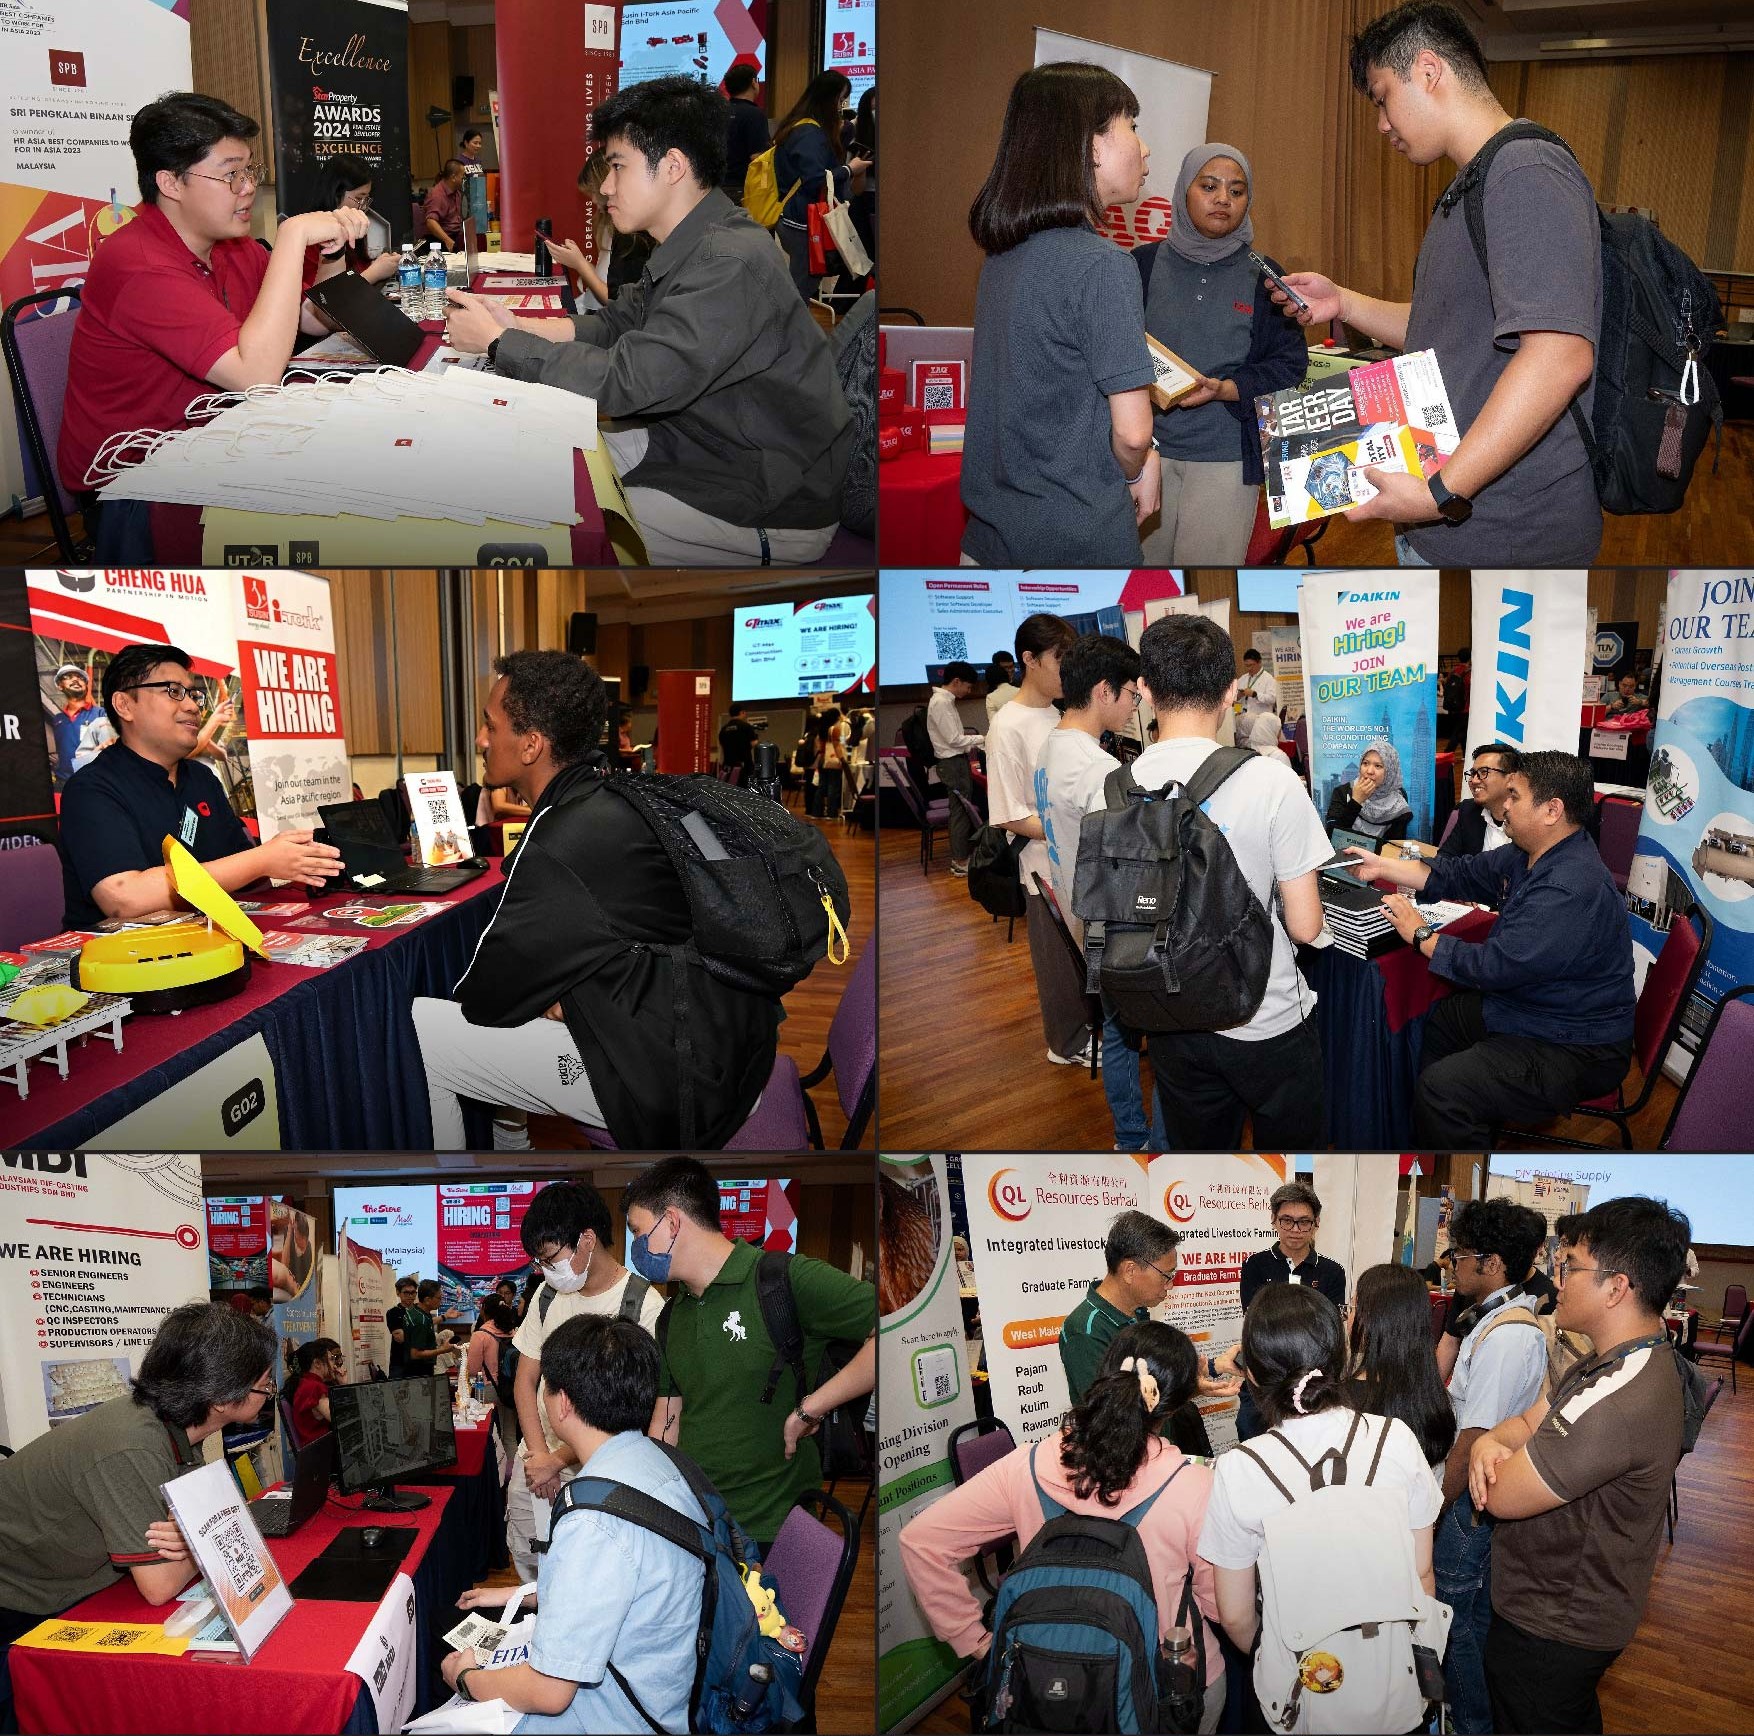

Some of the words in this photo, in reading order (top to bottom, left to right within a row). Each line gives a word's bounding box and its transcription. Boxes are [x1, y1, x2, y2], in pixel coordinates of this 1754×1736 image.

[298, 33, 392, 75] Excellence
[58, 62, 77, 75] SPB
[10, 108, 26, 117] SRI
[29, 109, 87, 120] PENGKALAN
[90, 112, 124, 122] BINAAN
[313, 104, 381, 122] AWARDS
[313, 122, 350, 137] 2024
[13, 137, 25, 145] HR
[315, 143, 382, 153] EXCELLENCE
[16, 162, 56, 170] MALAYSIA
[1326, 387, 1356, 425] DAY
[104, 570, 166, 591] CHENG
[171, 574, 207, 596] HUA
[1349, 591, 1401, 603] DAIKIN
[1345, 618, 1366, 631] We
[1370, 612, 1391, 624] are
[1669, 614, 1712, 640] OUR
[1333, 621, 1406, 657] Hiring!
[1693, 646, 1723, 655] Growth
[254, 649, 290, 689] WE
[292, 656, 329, 692] ARE
[1351, 655, 1385, 673] JOIN
[1700, 662, 1737, 671] Overseas
[1318, 676, 1361, 703] OUR
[1365, 662, 1426, 693] TEAM
[256, 691, 336, 734] HIRING
[304, 778, 322, 787] team
[281, 795, 295, 805] Asia
[297, 791, 319, 803] Pacific
[320, 791, 341, 802] region
[557, 1055, 570, 1086] Kappa
[231, 1091, 259, 1123] G02
[1576, 1170, 1612, 1183] Supply
[1002, 1185, 1027, 1205] QL
[1036, 1187, 1099, 1206] Resources
[1103, 1191, 1138, 1207] Berhad
[1174, 1194, 1192, 1211] QL
[378, 1204, 402, 1214] Store
[1199, 1195, 1246, 1211] Resources
[210, 1211, 240, 1226] HIRING
[444, 1206, 491, 1227] HIRING
[1211, 1227, 1251, 1239] Livestock
[987, 1238, 1054, 1254] Integrated
[0, 1243, 30, 1259] WE
[35, 1245, 74, 1262] ARE
[78, 1248, 142, 1267] HIRING
[1182, 1253, 1202, 1265] WE
[1205, 1252, 1226, 1265] ARE
[40, 1269, 76, 1279] SENIOR
[78, 1271, 129, 1281] ENGINEERS
[1183, 1271, 1217, 1282] Graduate
[1219, 1271, 1237, 1280] Farm
[42, 1281, 95, 1291] ENGINEERS
[1022, 1279, 1066, 1293] Graduate
[1068, 1279, 1091, 1289] Farm
[43, 1293, 105, 1302] TECHNICIANS
[46, 1317, 61, 1325] QC
[62, 1316, 119, 1325] INSPECTORS
[48, 1328, 108, 1337] PRODUCTION
[110, 1327, 157, 1336] OPERATORS
[1010, 1329, 1037, 1341] West
[49, 1339, 114, 1348] SUPERVISORS
[124, 1338, 142, 1347] LINE
[1015, 1364, 1048, 1379] Pajam
[1018, 1382, 1044, 1396] Raub
[1020, 1401, 1049, 1415] Kulim
[903, 1416, 950, 1441] Division
[884, 1443, 931, 1469] Opening
[895, 1473, 938, 1497] Positions
[492, 1643, 530, 1665] EITA
